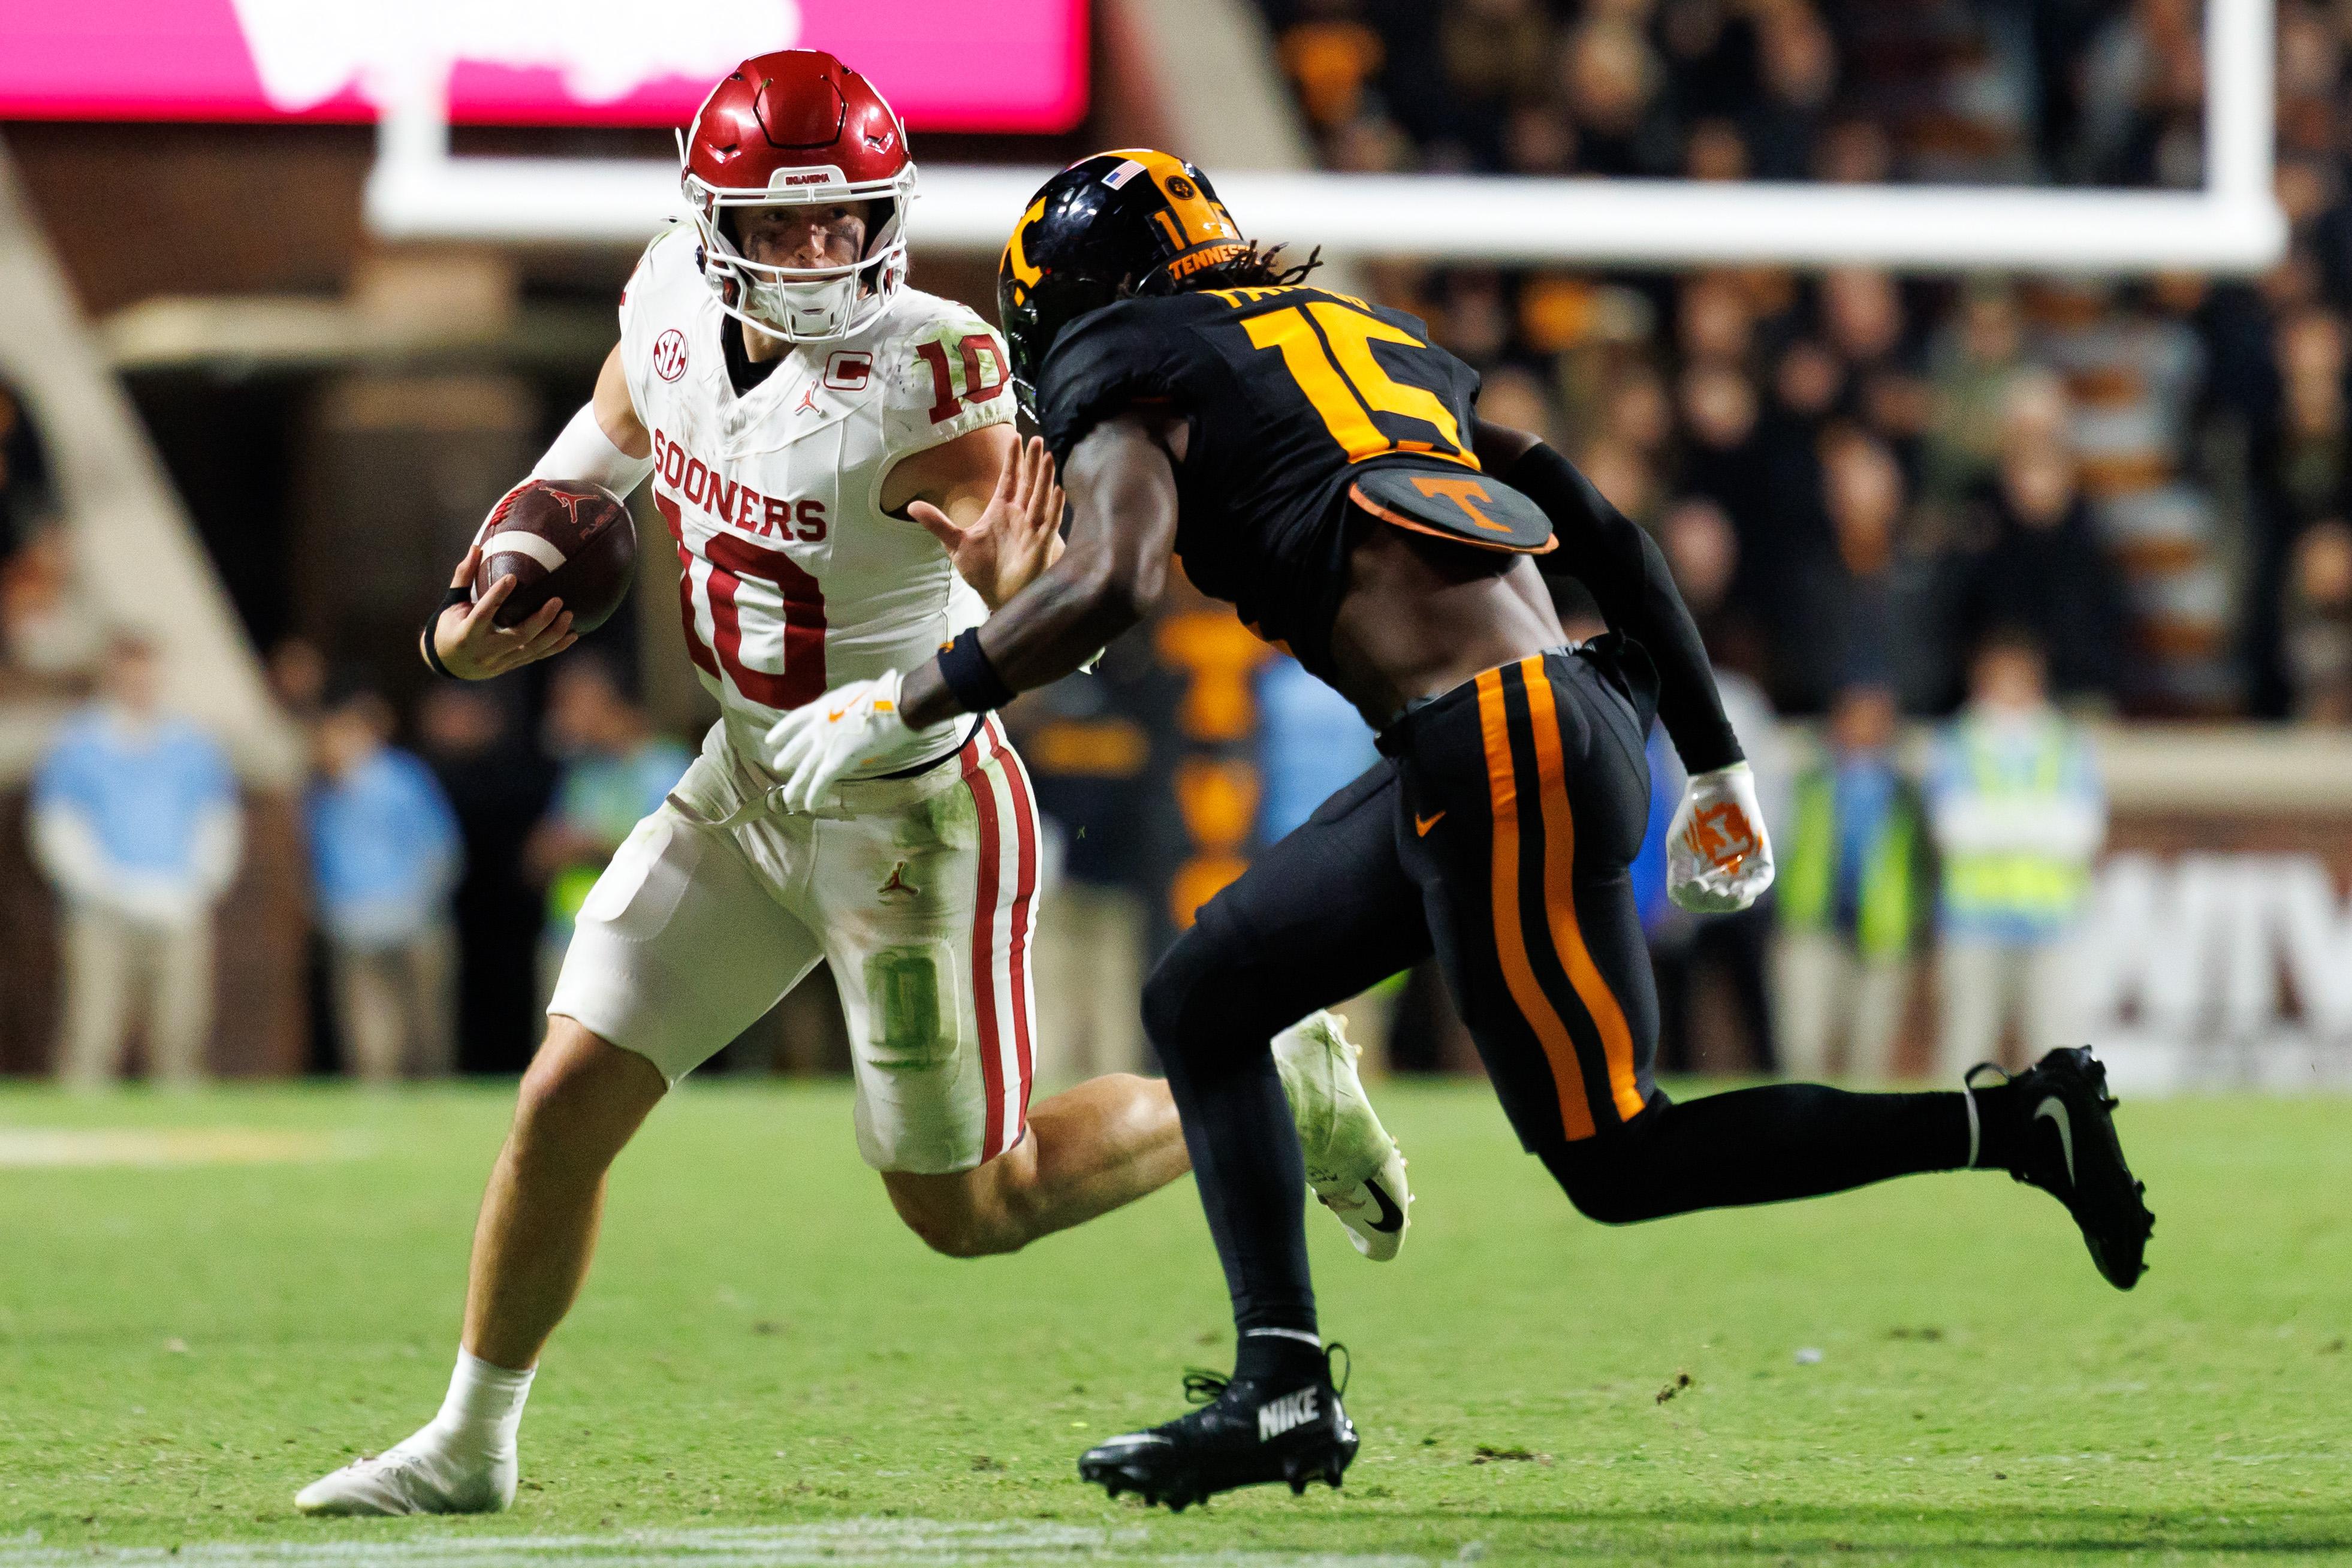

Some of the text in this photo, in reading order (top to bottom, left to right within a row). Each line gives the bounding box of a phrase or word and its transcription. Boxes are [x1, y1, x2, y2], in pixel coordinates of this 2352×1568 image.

[1169, 243, 1261, 281] TENNES
[653, 330, 686, 380] SEC
[824, 350, 873, 391] C
[916, 334, 1011, 425] 10
[1240, 301, 1481, 472] 15
[655, 428, 827, 542] SOONERS
[1410, 477, 1513, 533] T
[655, 486, 828, 710] 10
[1259, 1385, 1319, 1443] NIKE
